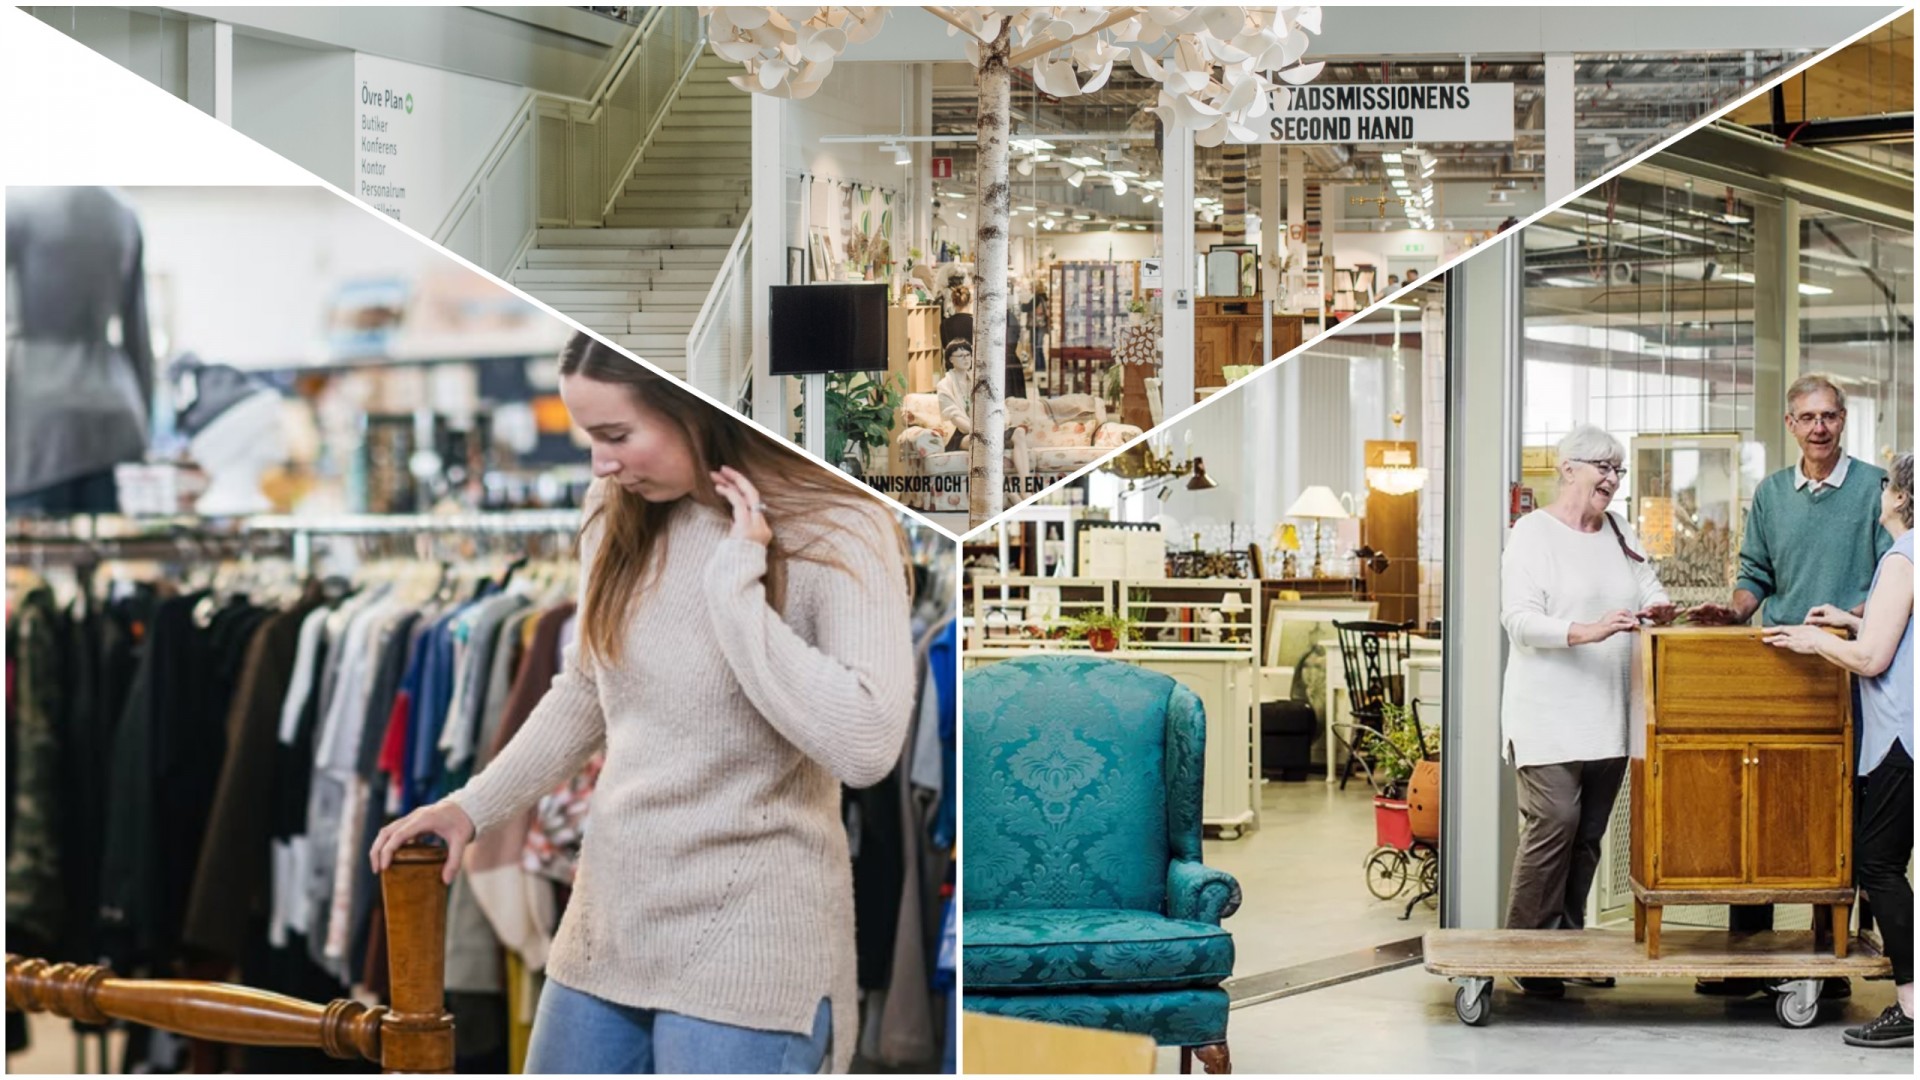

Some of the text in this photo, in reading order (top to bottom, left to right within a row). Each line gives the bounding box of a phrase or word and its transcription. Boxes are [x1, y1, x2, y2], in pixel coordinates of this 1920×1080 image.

[361, 80, 404, 110] Övre Plan
[361, 114, 388, 133] Butiker
[1270, 116, 1414, 141] SECOND HAND
[361, 136, 397, 156] Konferens
[361, 158, 386, 176] Kontor
[361, 180, 406, 199] Personalrum
[935, 475, 961, 493] OCH
[1024, 476, 1044, 493] EN
